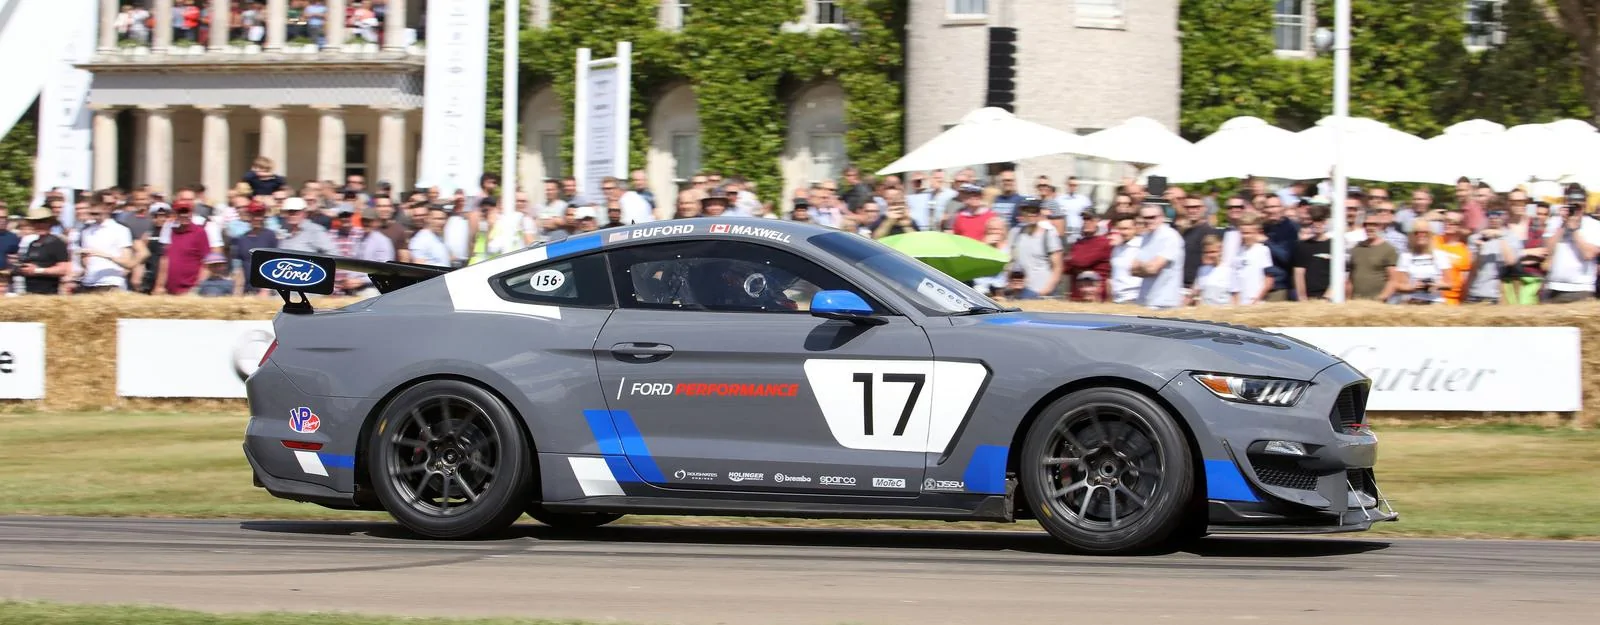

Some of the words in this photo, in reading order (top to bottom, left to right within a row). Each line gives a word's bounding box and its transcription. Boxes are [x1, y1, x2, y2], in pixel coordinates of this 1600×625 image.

[632, 224, 694, 239] BUFORD
[731, 225, 791, 244] MAXWELL
[271, 261, 314, 282] Ford
[630, 382, 674, 397] FORD
[674, 383, 799, 398] PERFORMANCE
[852, 372, 926, 437] 17
[290, 407, 311, 432] VP
[728, 471, 764, 479] HOLINGER
[784, 475, 812, 483] brembo
[819, 476, 857, 486] sparco
